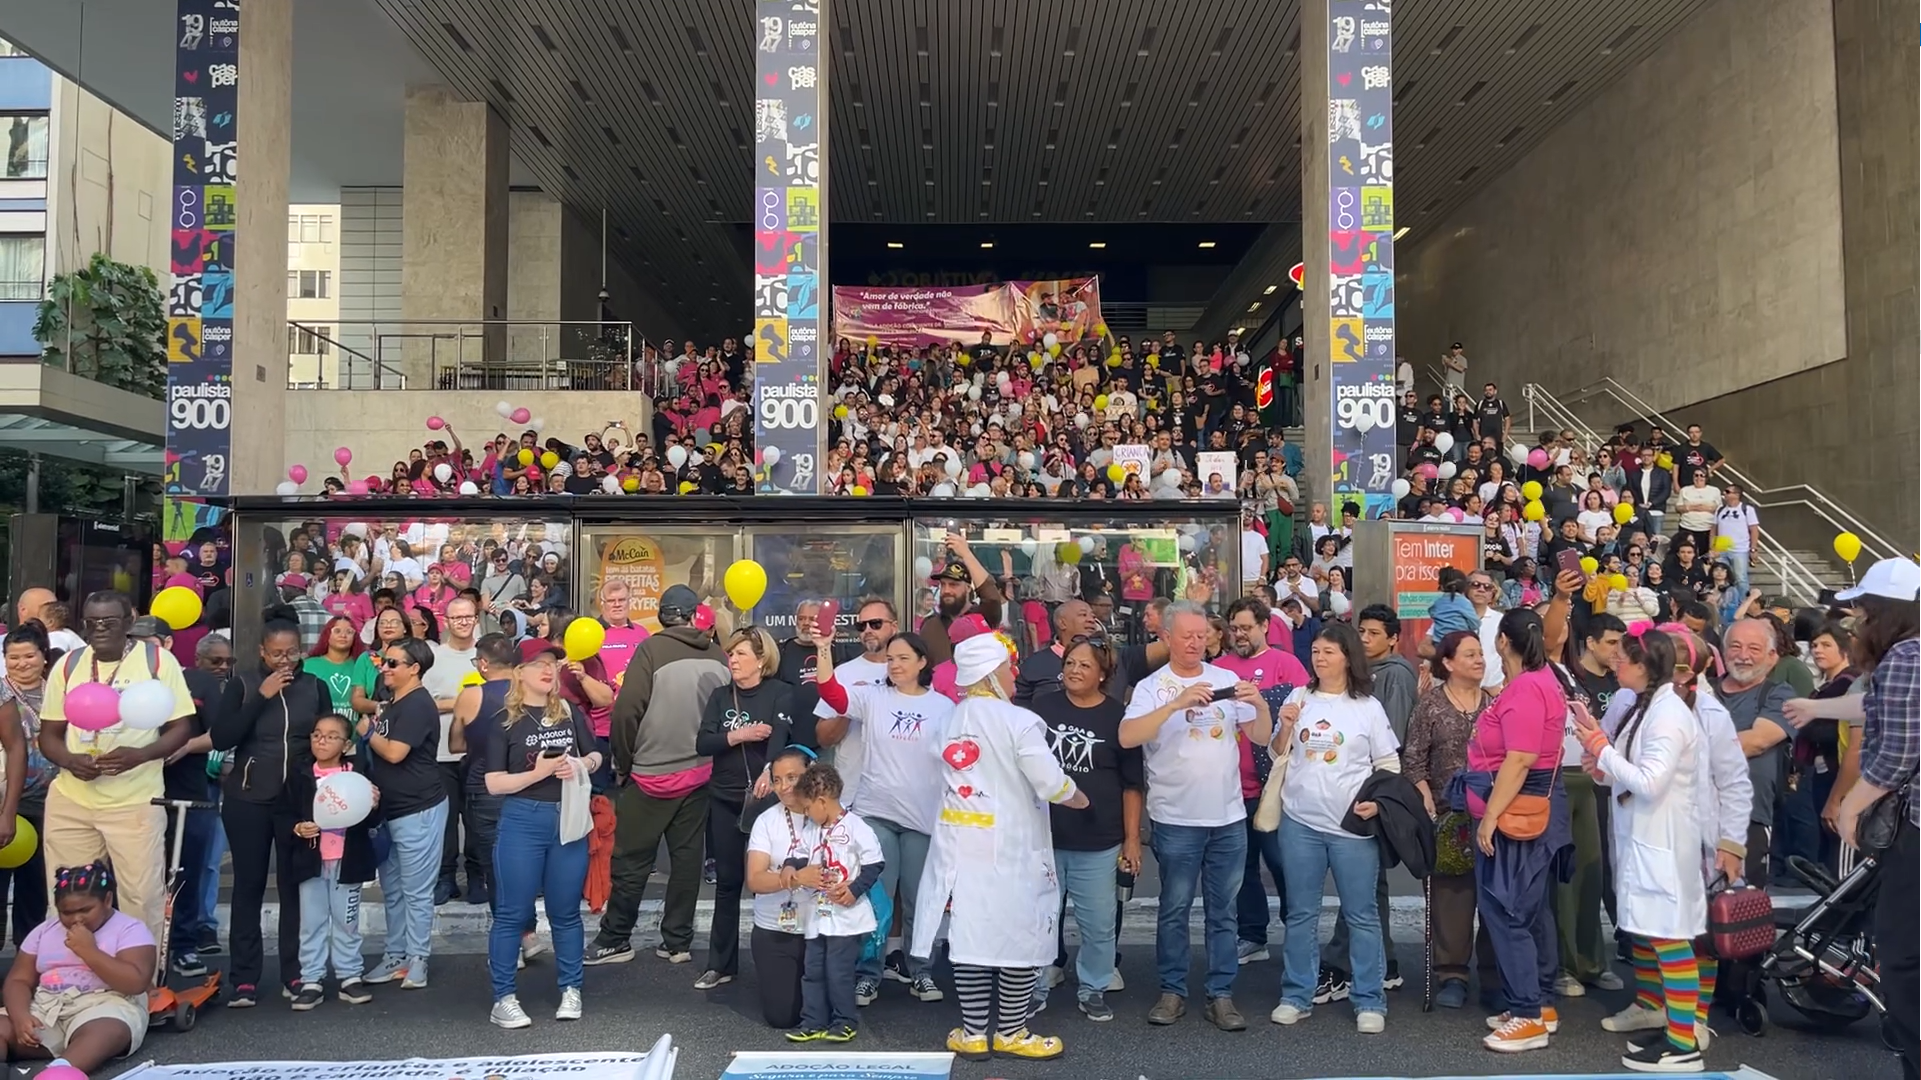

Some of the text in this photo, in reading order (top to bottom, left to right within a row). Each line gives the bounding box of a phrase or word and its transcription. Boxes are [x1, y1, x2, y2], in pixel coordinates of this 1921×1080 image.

[182, 14, 204, 34] 19
[760, 16, 782, 36] 19
[1332, 16, 1355, 36] 19
[887, 292, 898, 300] de
[901, 291, 934, 300] verdade
[936, 290, 952, 298] não
[172, 382, 231, 400] paulista
[760, 383, 818, 401] paulista
[1337, 382, 1395, 400] paulista
[172, 398, 231, 429] 900
[761, 398, 818, 429] 900
[1337, 398, 1396, 429] 900
[202, 454, 225, 474] 19
[791, 453, 813, 473] 19
[1368, 453, 1392, 473] 19
[616, 547, 649, 560] McCain
[1394, 538, 1454, 559] Tem Inter
[630, 564, 657, 573] batatas
[1396, 565, 1416, 584] pra
[765, 615, 786, 626] UM
[538, 729, 567, 741] Adotar
[346, 885, 361, 925] YORK
[327, 1061, 445, 1073] crianças
[484, 1064, 587, 1074] filiação
[765, 1063, 917, 1071] ADOÇÃO LEGAL
